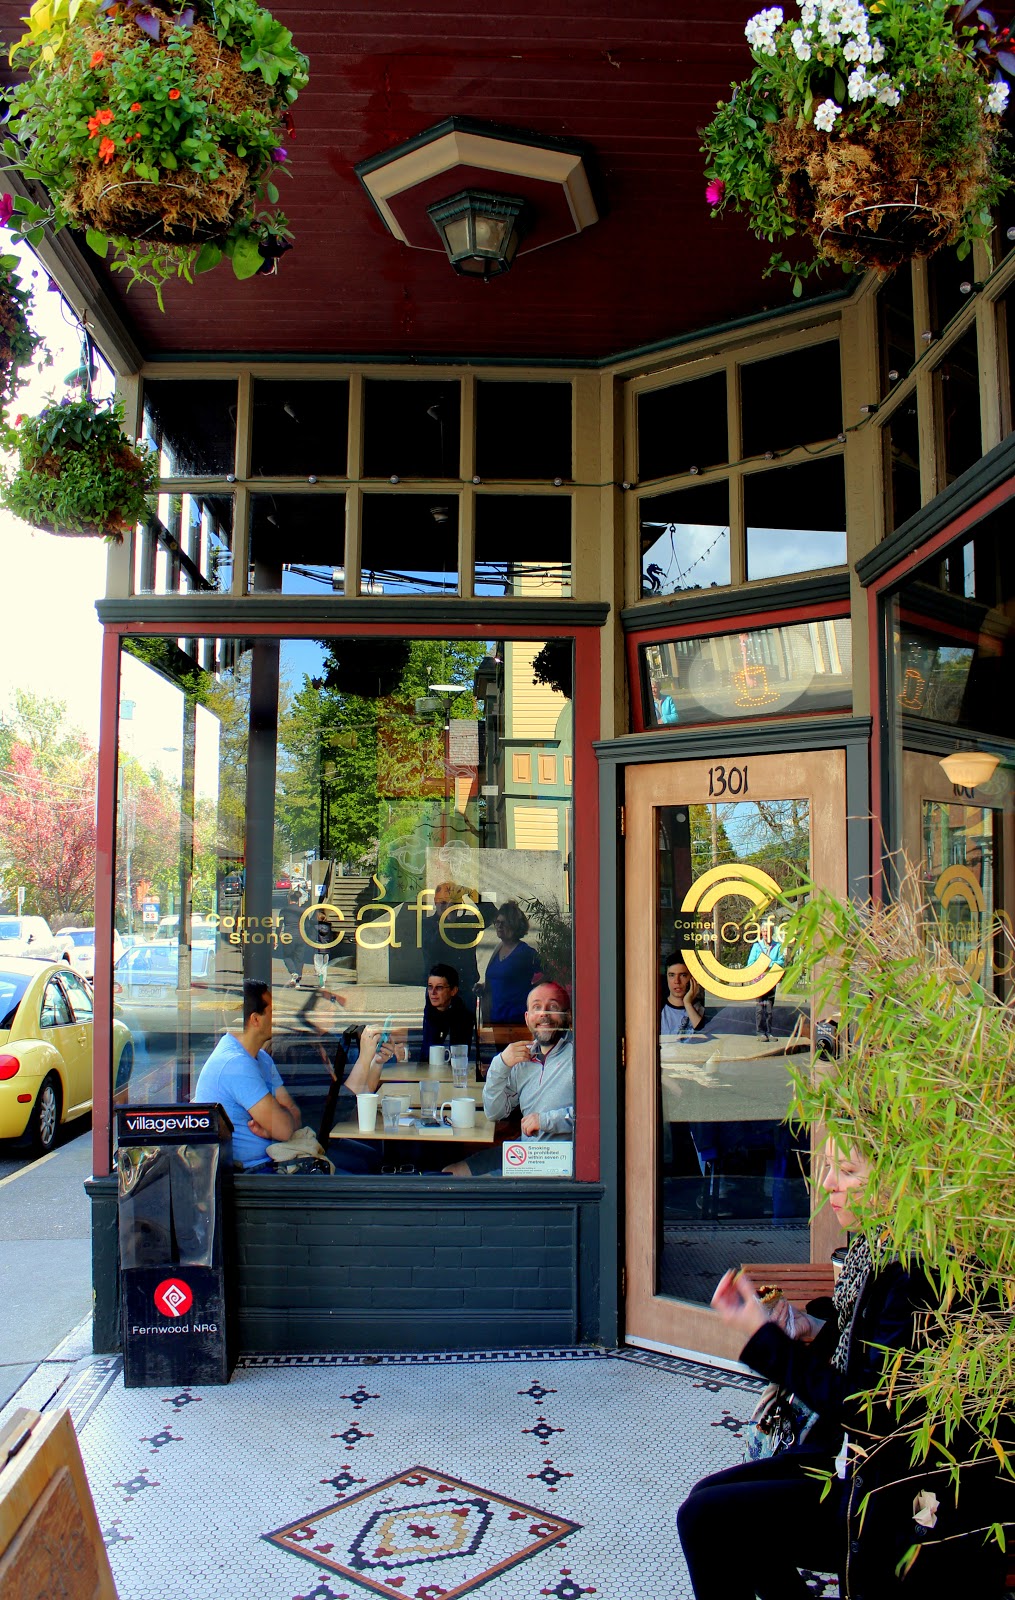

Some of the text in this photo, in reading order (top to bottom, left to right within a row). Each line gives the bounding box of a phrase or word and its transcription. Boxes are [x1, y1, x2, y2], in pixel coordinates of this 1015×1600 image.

[708, 765, 749, 797] 1301
[205, 913, 285, 928] Corner
[674, 919, 716, 929] Corner
[229, 930, 293, 945] stone
[683, 932, 718, 941] stone
[126, 1115, 210, 1133] villagevibe
[132, 1323, 218, 1335] Fernwood NRG
